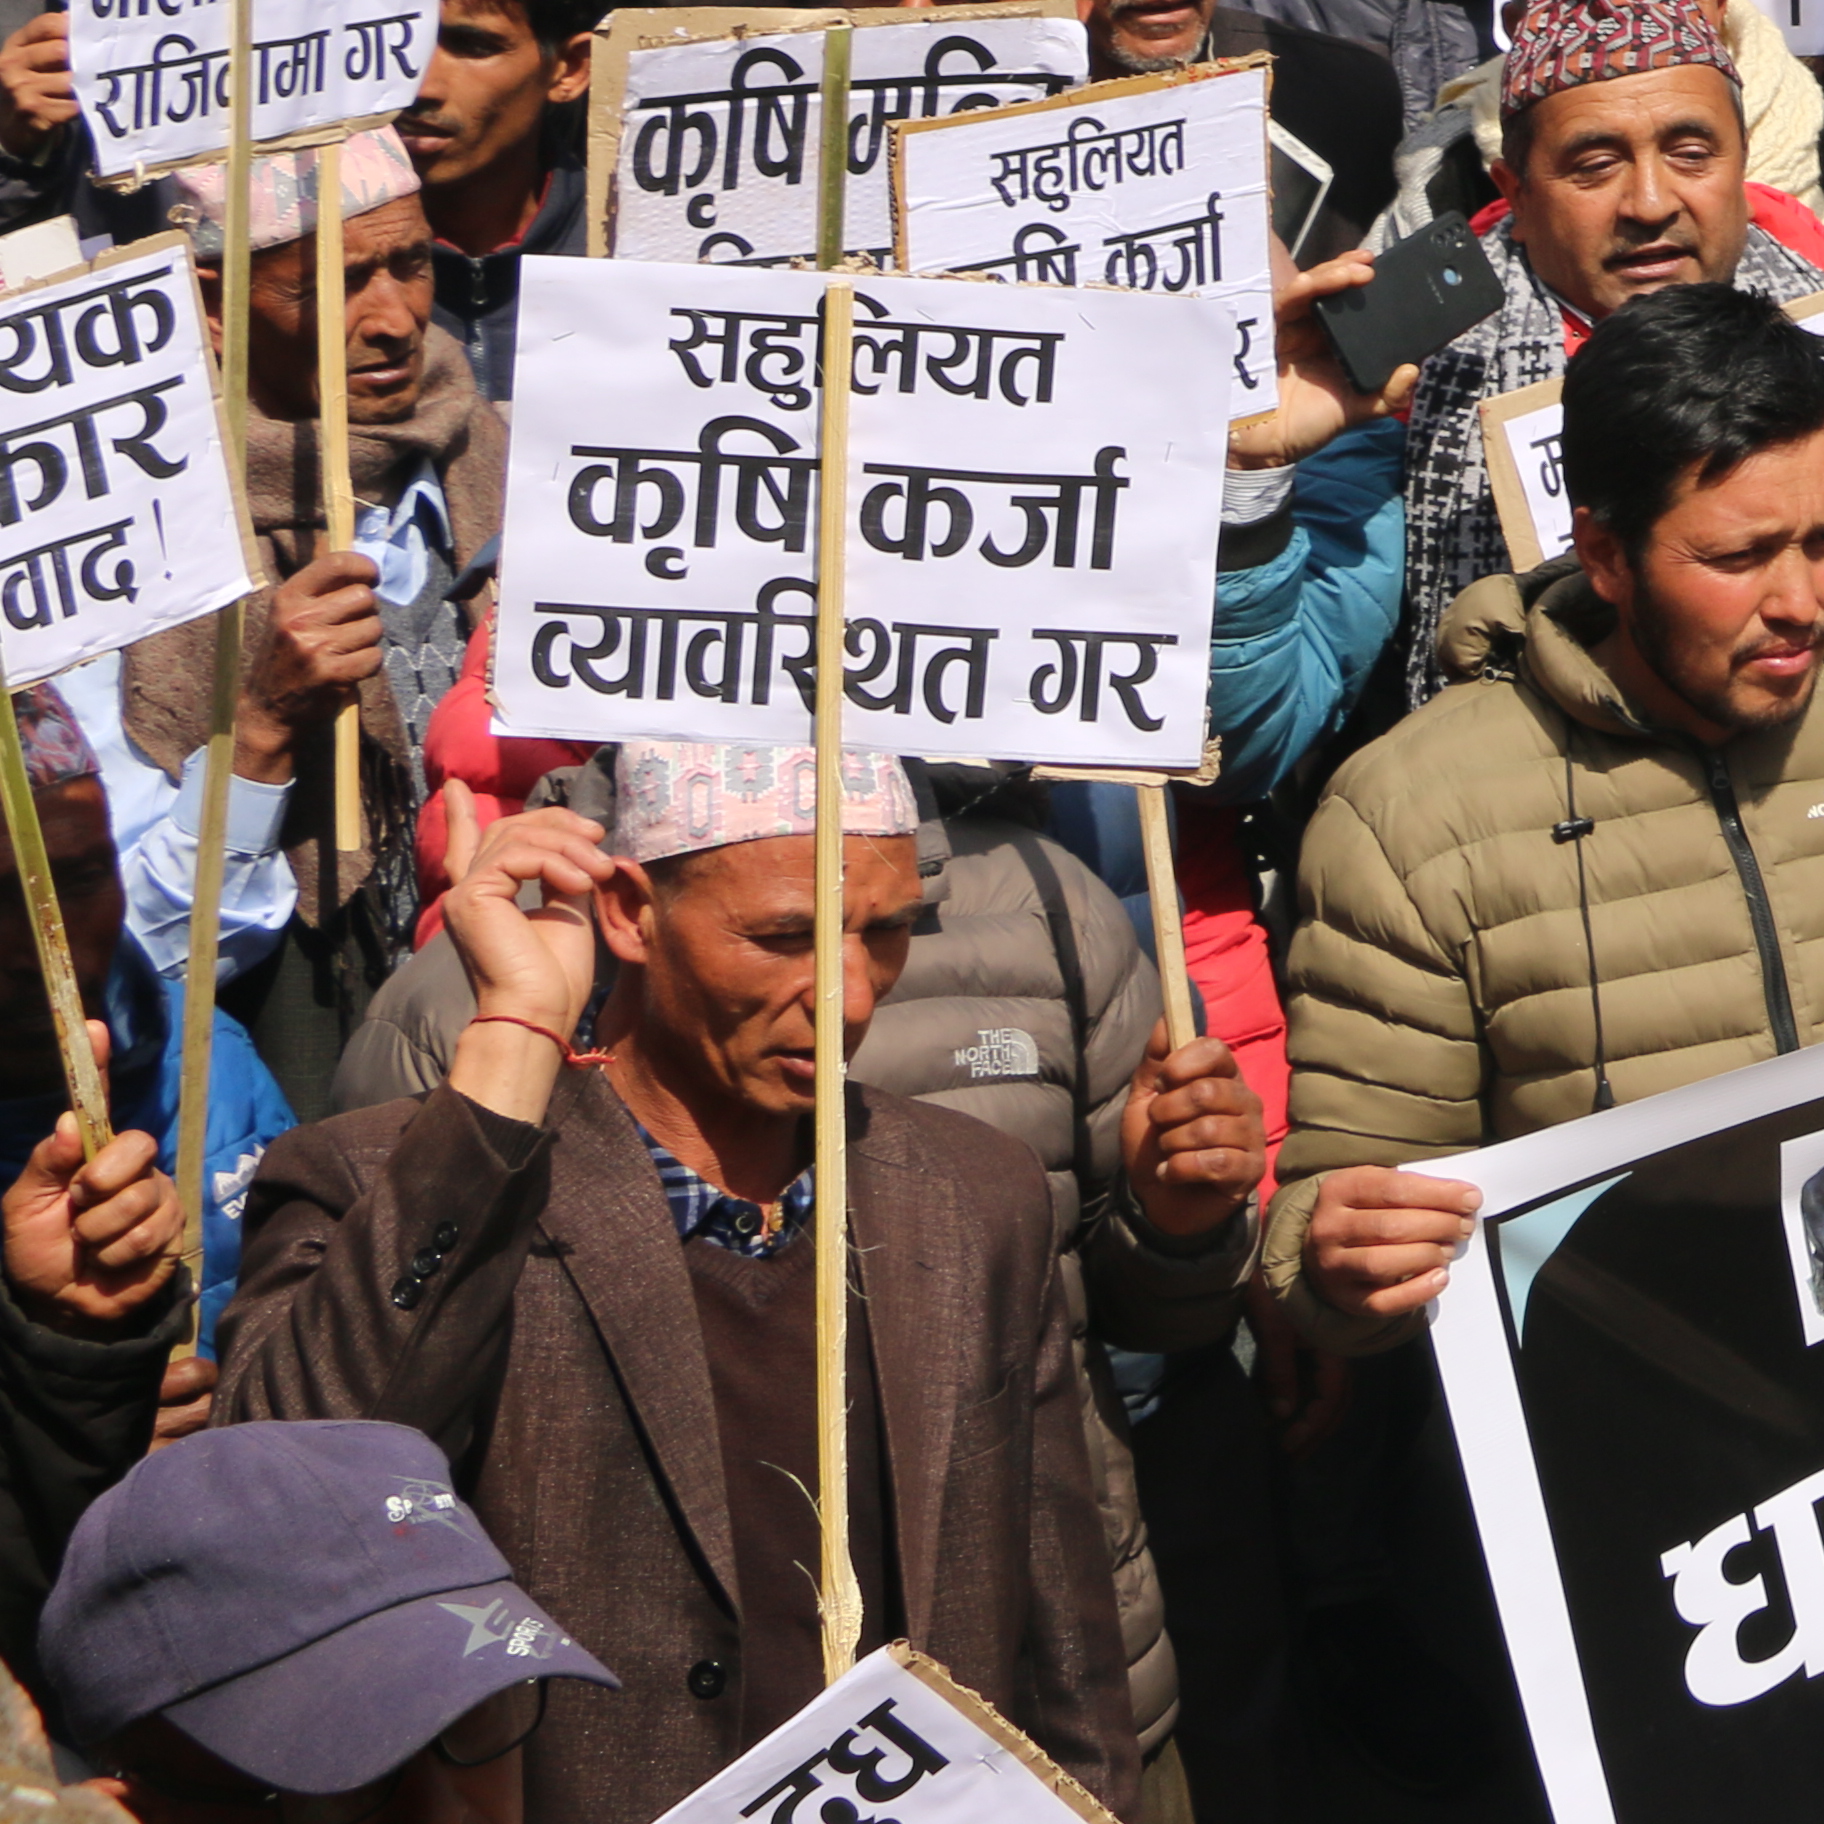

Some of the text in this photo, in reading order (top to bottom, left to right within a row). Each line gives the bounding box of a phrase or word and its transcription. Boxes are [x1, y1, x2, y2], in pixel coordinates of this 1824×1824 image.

[344, 11, 423, 81] गर
[990, 117, 1187, 209] सहुलियत
[566, 414, 1130, 581] कृषि कर्जा
[1029, 628, 1179, 732] गर
[955, 1044, 1012, 1066] NORTH
[971, 1060, 1013, 1078] FACE
[977, 1029, 1012, 1044] THE
